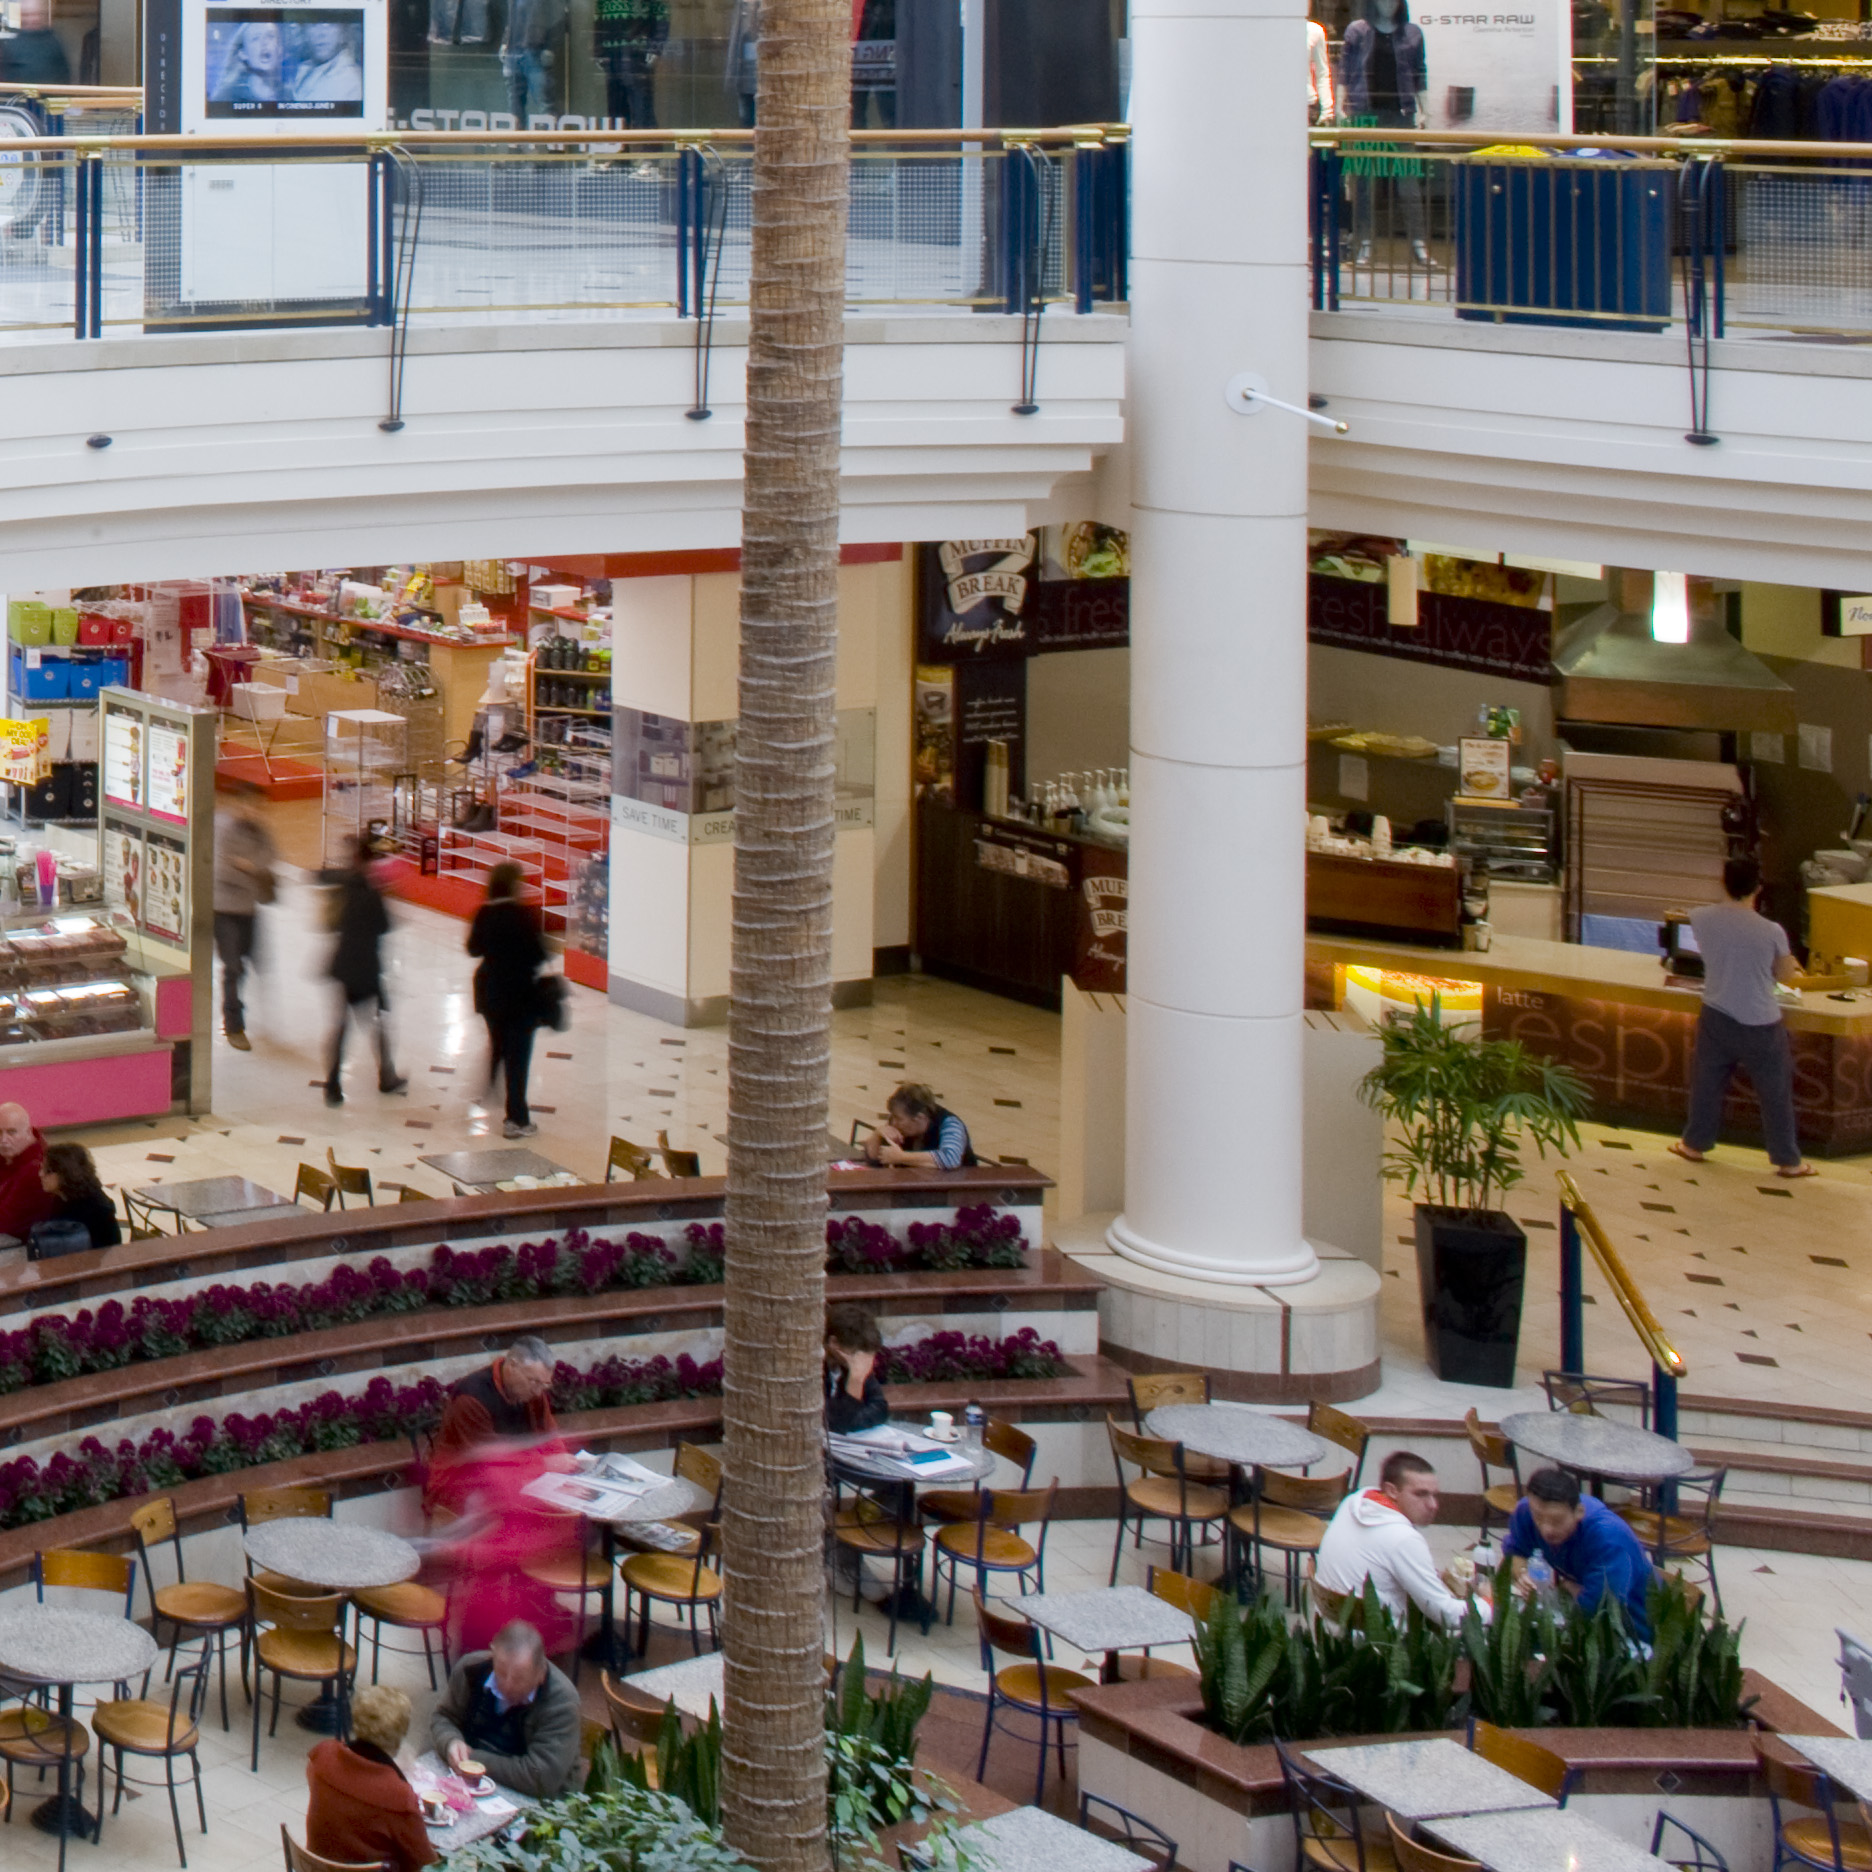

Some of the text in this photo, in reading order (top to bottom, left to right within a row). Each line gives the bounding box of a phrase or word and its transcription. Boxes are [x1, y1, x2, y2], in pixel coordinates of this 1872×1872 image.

[1419, 14, 1535, 26] G-STAR RAW
[159, 33, 167, 131] DIRECTOR
[956, 577, 1020, 599] BREAK
[1063, 586, 1127, 632] fres
[1310, 588, 1392, 639] resh
[622, 806, 678, 833] SAVE TIME
[834, 807, 862, 822] TIME
[704, 819, 736, 835] CREA
[1090, 879, 1126, 894] MUF
[1096, 912, 1126, 928] BRE
[1496, 986, 1544, 1011] latte
